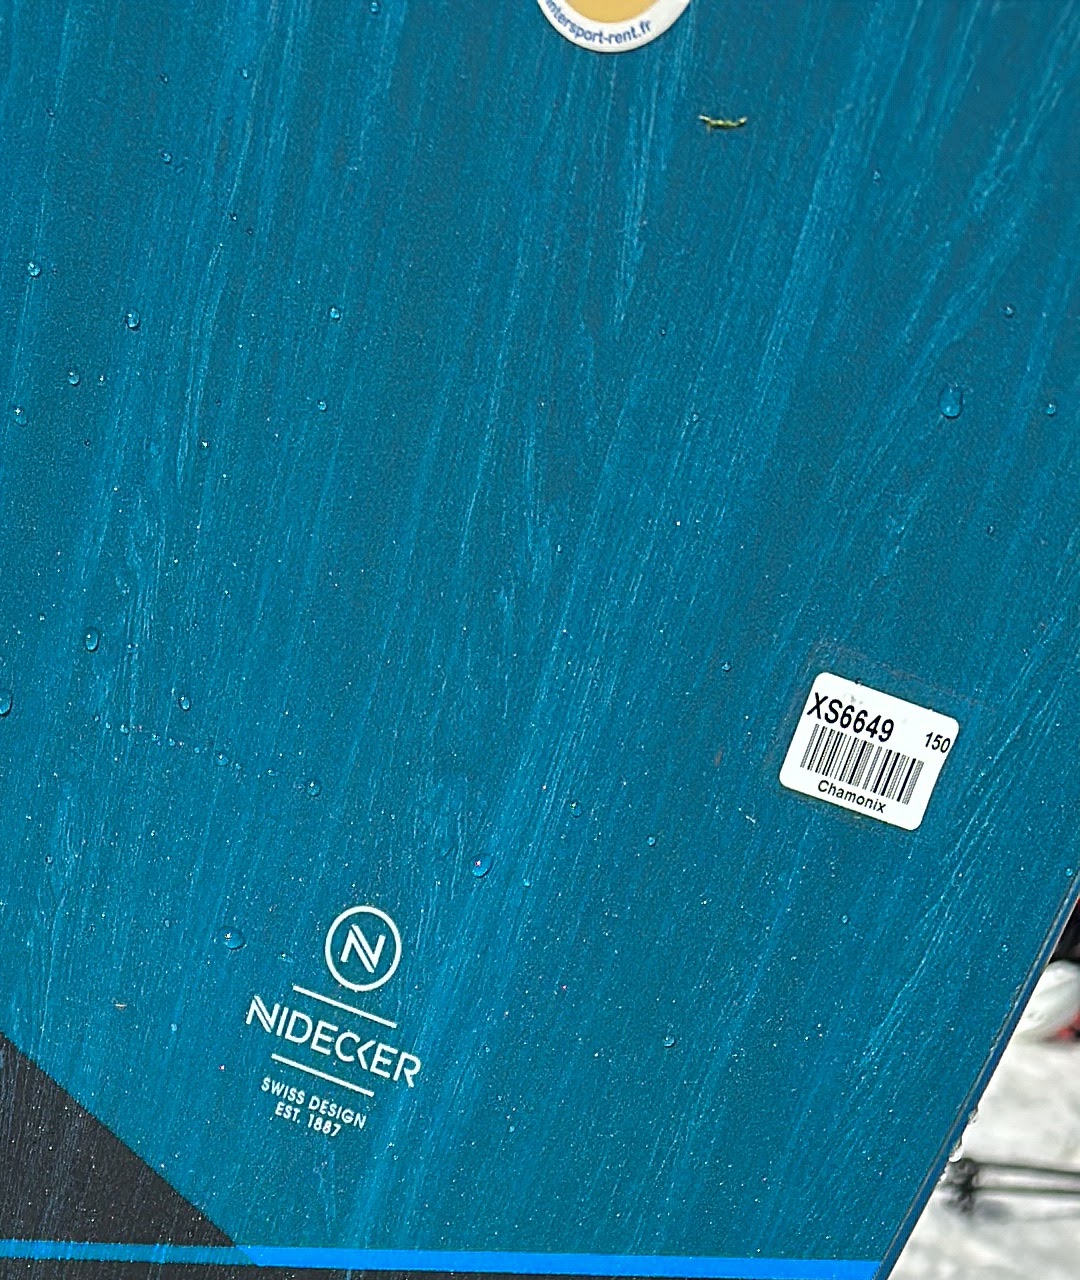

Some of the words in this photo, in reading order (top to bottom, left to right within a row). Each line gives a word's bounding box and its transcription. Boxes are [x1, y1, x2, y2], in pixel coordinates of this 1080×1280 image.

[807, 692, 894, 743] XS6649
[925, 732, 951, 754] 150
[817, 779, 887, 814] Chamonix
[245, 995, 421, 1088] NIDECKER
[261, 1077, 306, 1105] SWISS
[308, 1095, 367, 1130] DESIGN
[275, 1102, 301, 1124] EST.
[307, 1113, 342, 1137] 1887
